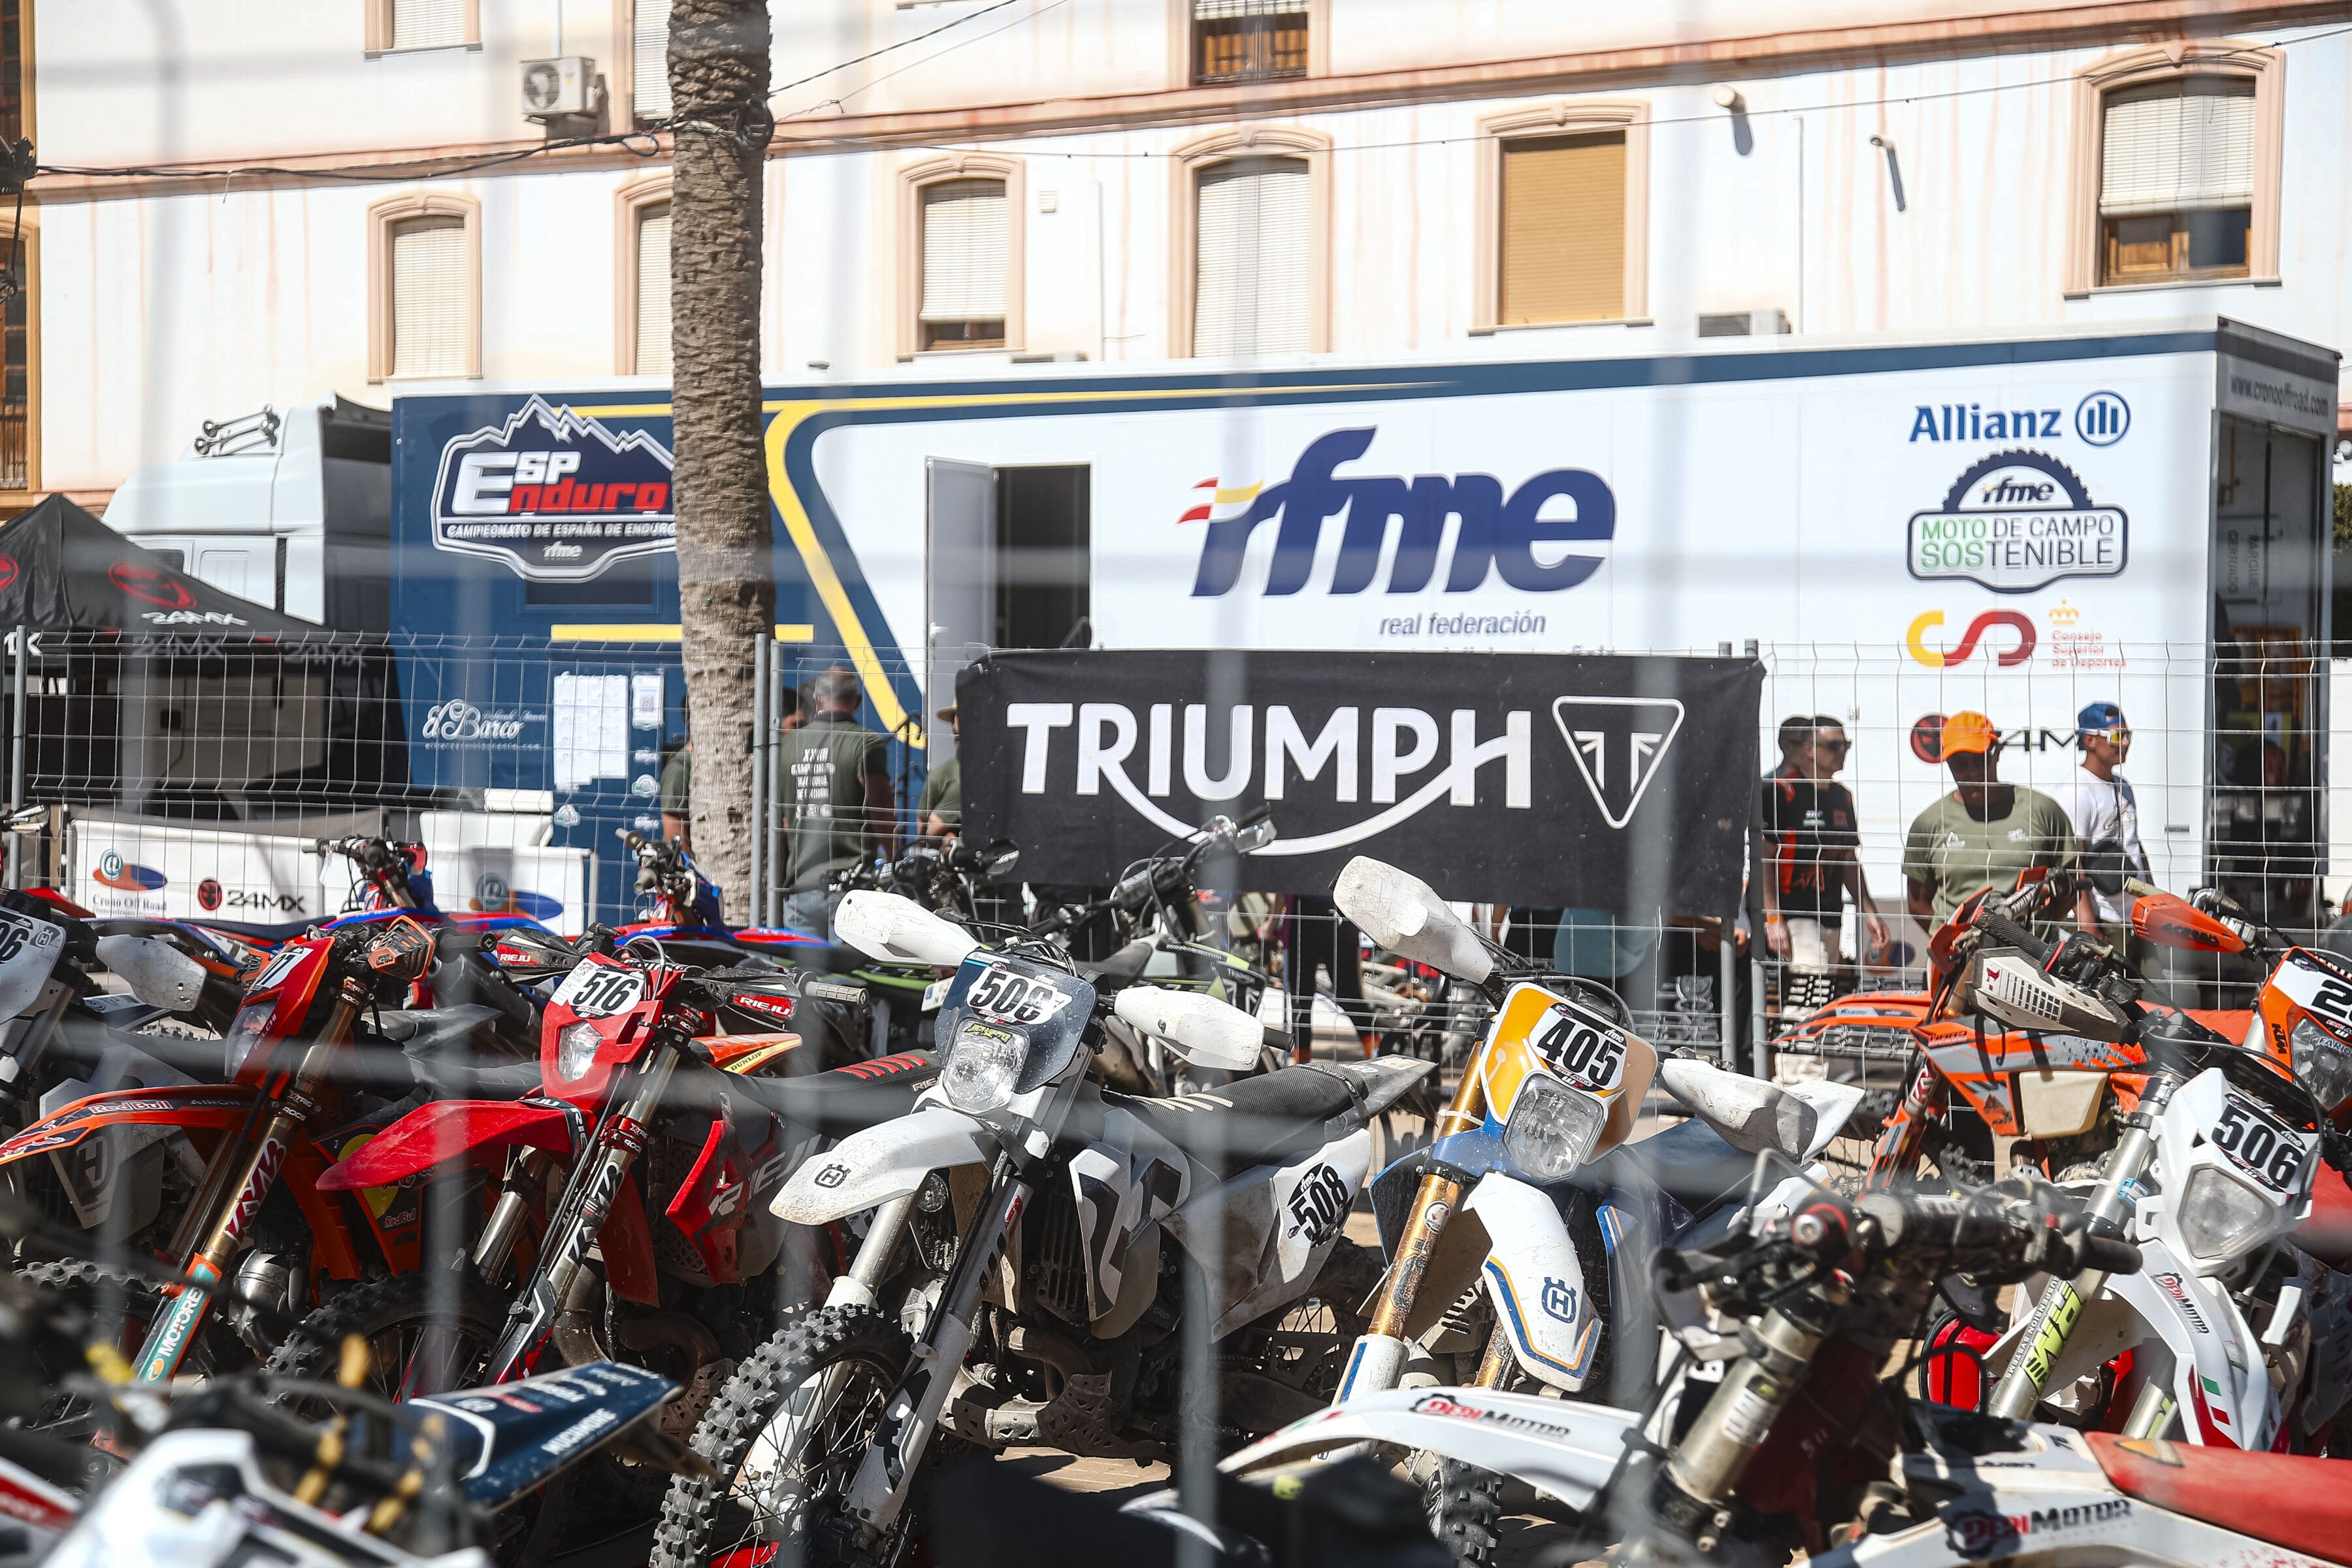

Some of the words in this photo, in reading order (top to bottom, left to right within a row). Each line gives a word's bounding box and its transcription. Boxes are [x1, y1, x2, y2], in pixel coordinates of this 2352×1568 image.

[1909, 404, 2062, 443] Allianz
[1980, 476, 2055, 504] rfme
[1178, 425, 1617, 598] rfme
[447, 523, 532, 539] CAMPEONATO
[532, 523, 551, 538] DE
[553, 520, 600, 538] ESPAÑA
[604, 523, 622, 538] DE
[1922, 518, 1987, 540] MOTO
[1993, 516, 2023, 538] DE
[2029, 514, 2114, 538] CAMPO
[1922, 537, 2114, 570] SOSTENIBLE
[1379, 612, 1423, 635] real
[1428, 609, 1548, 635] federación
[2051, 629, 2102, 642] Consejo
[2051, 644, 2106, 657] Superior
[2051, 657, 2068, 668] de
[1007, 702, 1532, 840] TRIUMPH
[92, 894, 122, 907] Crono
[142, 898, 167, 911] Road
[228, 889, 306, 913] 24MX
[500, 953, 532, 962] RIEJU
[572, 971, 640, 1012] 516
[970, 971, 1053, 1022] 508
[2311, 980, 2352, 1018] 2
[739, 996, 791, 1015] RIEJU
[1604, 1028, 1625, 1043] rfme
[2271, 1022, 2289, 1054] KTM
[730, 1051, 763, 1071] DUNLOP
[1536, 1017, 1625, 1087] 405
[90, 1100, 131, 1115] Red
[131, 1100, 174, 1112] Bull
[191, 1098, 240, 1107] AIROH
[288, 1088, 312, 1109] XTRIG
[282, 1106, 306, 1122] ROCS
[2211, 1103, 2305, 1189] 506
[2280, 1130, 2302, 1147] rfme
[1299, 1172, 1316, 1194] rfme
[1290, 1165, 1349, 1242] 508
[385, 1212, 402, 1228] Red
[402, 1207, 417, 1222] Bull
[2029, 1275, 2059, 1336] SUSPENSION
[157, 1284, 208, 1358] MOTORE
[2006, 1335, 2030, 1381] SYSTEMS
